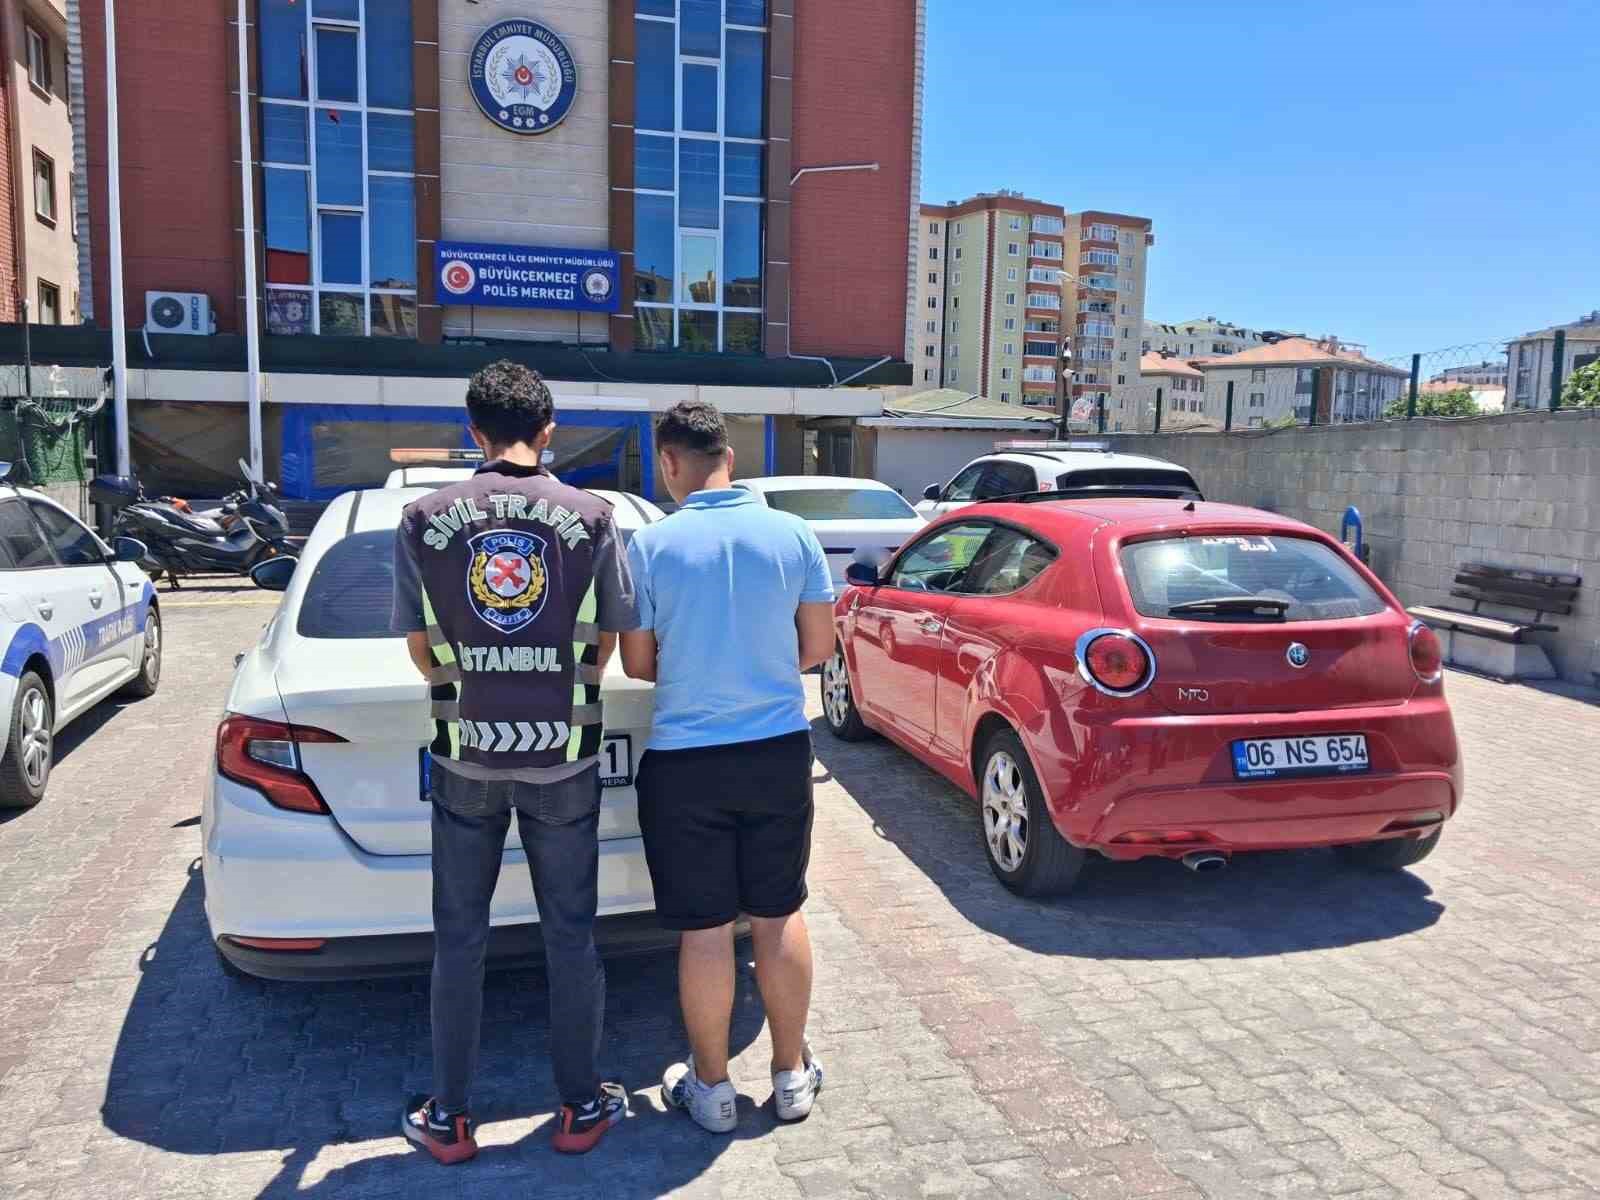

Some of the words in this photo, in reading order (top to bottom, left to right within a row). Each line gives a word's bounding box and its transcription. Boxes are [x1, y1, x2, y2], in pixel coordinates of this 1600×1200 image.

[513, 105, 535, 116] EGM
[479, 266, 577, 284] BÜYÜKÇEKMECE
[483, 282, 518, 298] POLİS
[521, 286, 574, 300] MERKEZİ
[1246, 742, 1275, 767] 06
[1285, 740, 1318, 765] NS
[1326, 737, 1366, 763] 654
